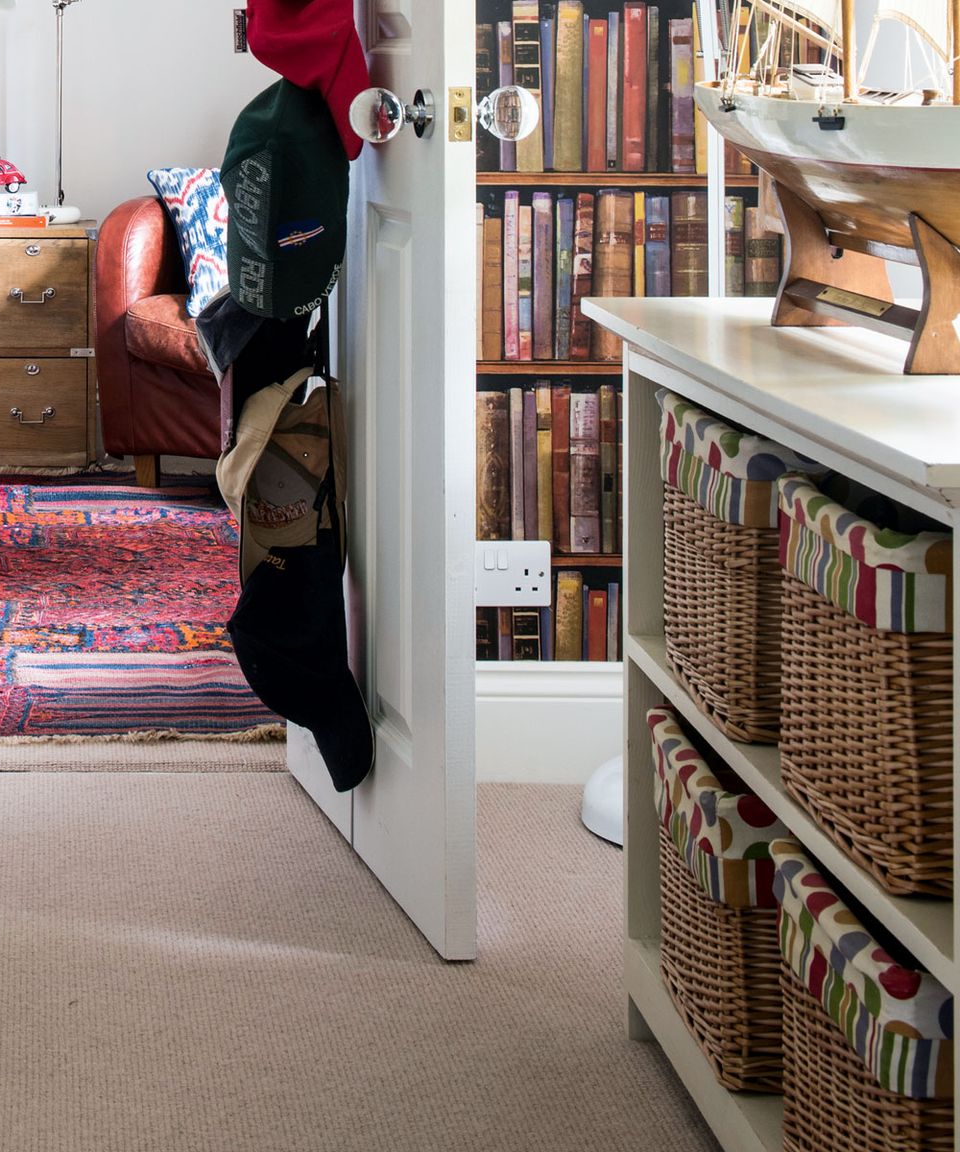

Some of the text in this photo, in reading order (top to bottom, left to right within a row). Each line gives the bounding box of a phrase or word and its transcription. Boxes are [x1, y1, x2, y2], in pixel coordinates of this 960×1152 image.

[234, 158, 270, 225] CABO
[294, 263, 343, 315] CABO VERDE
